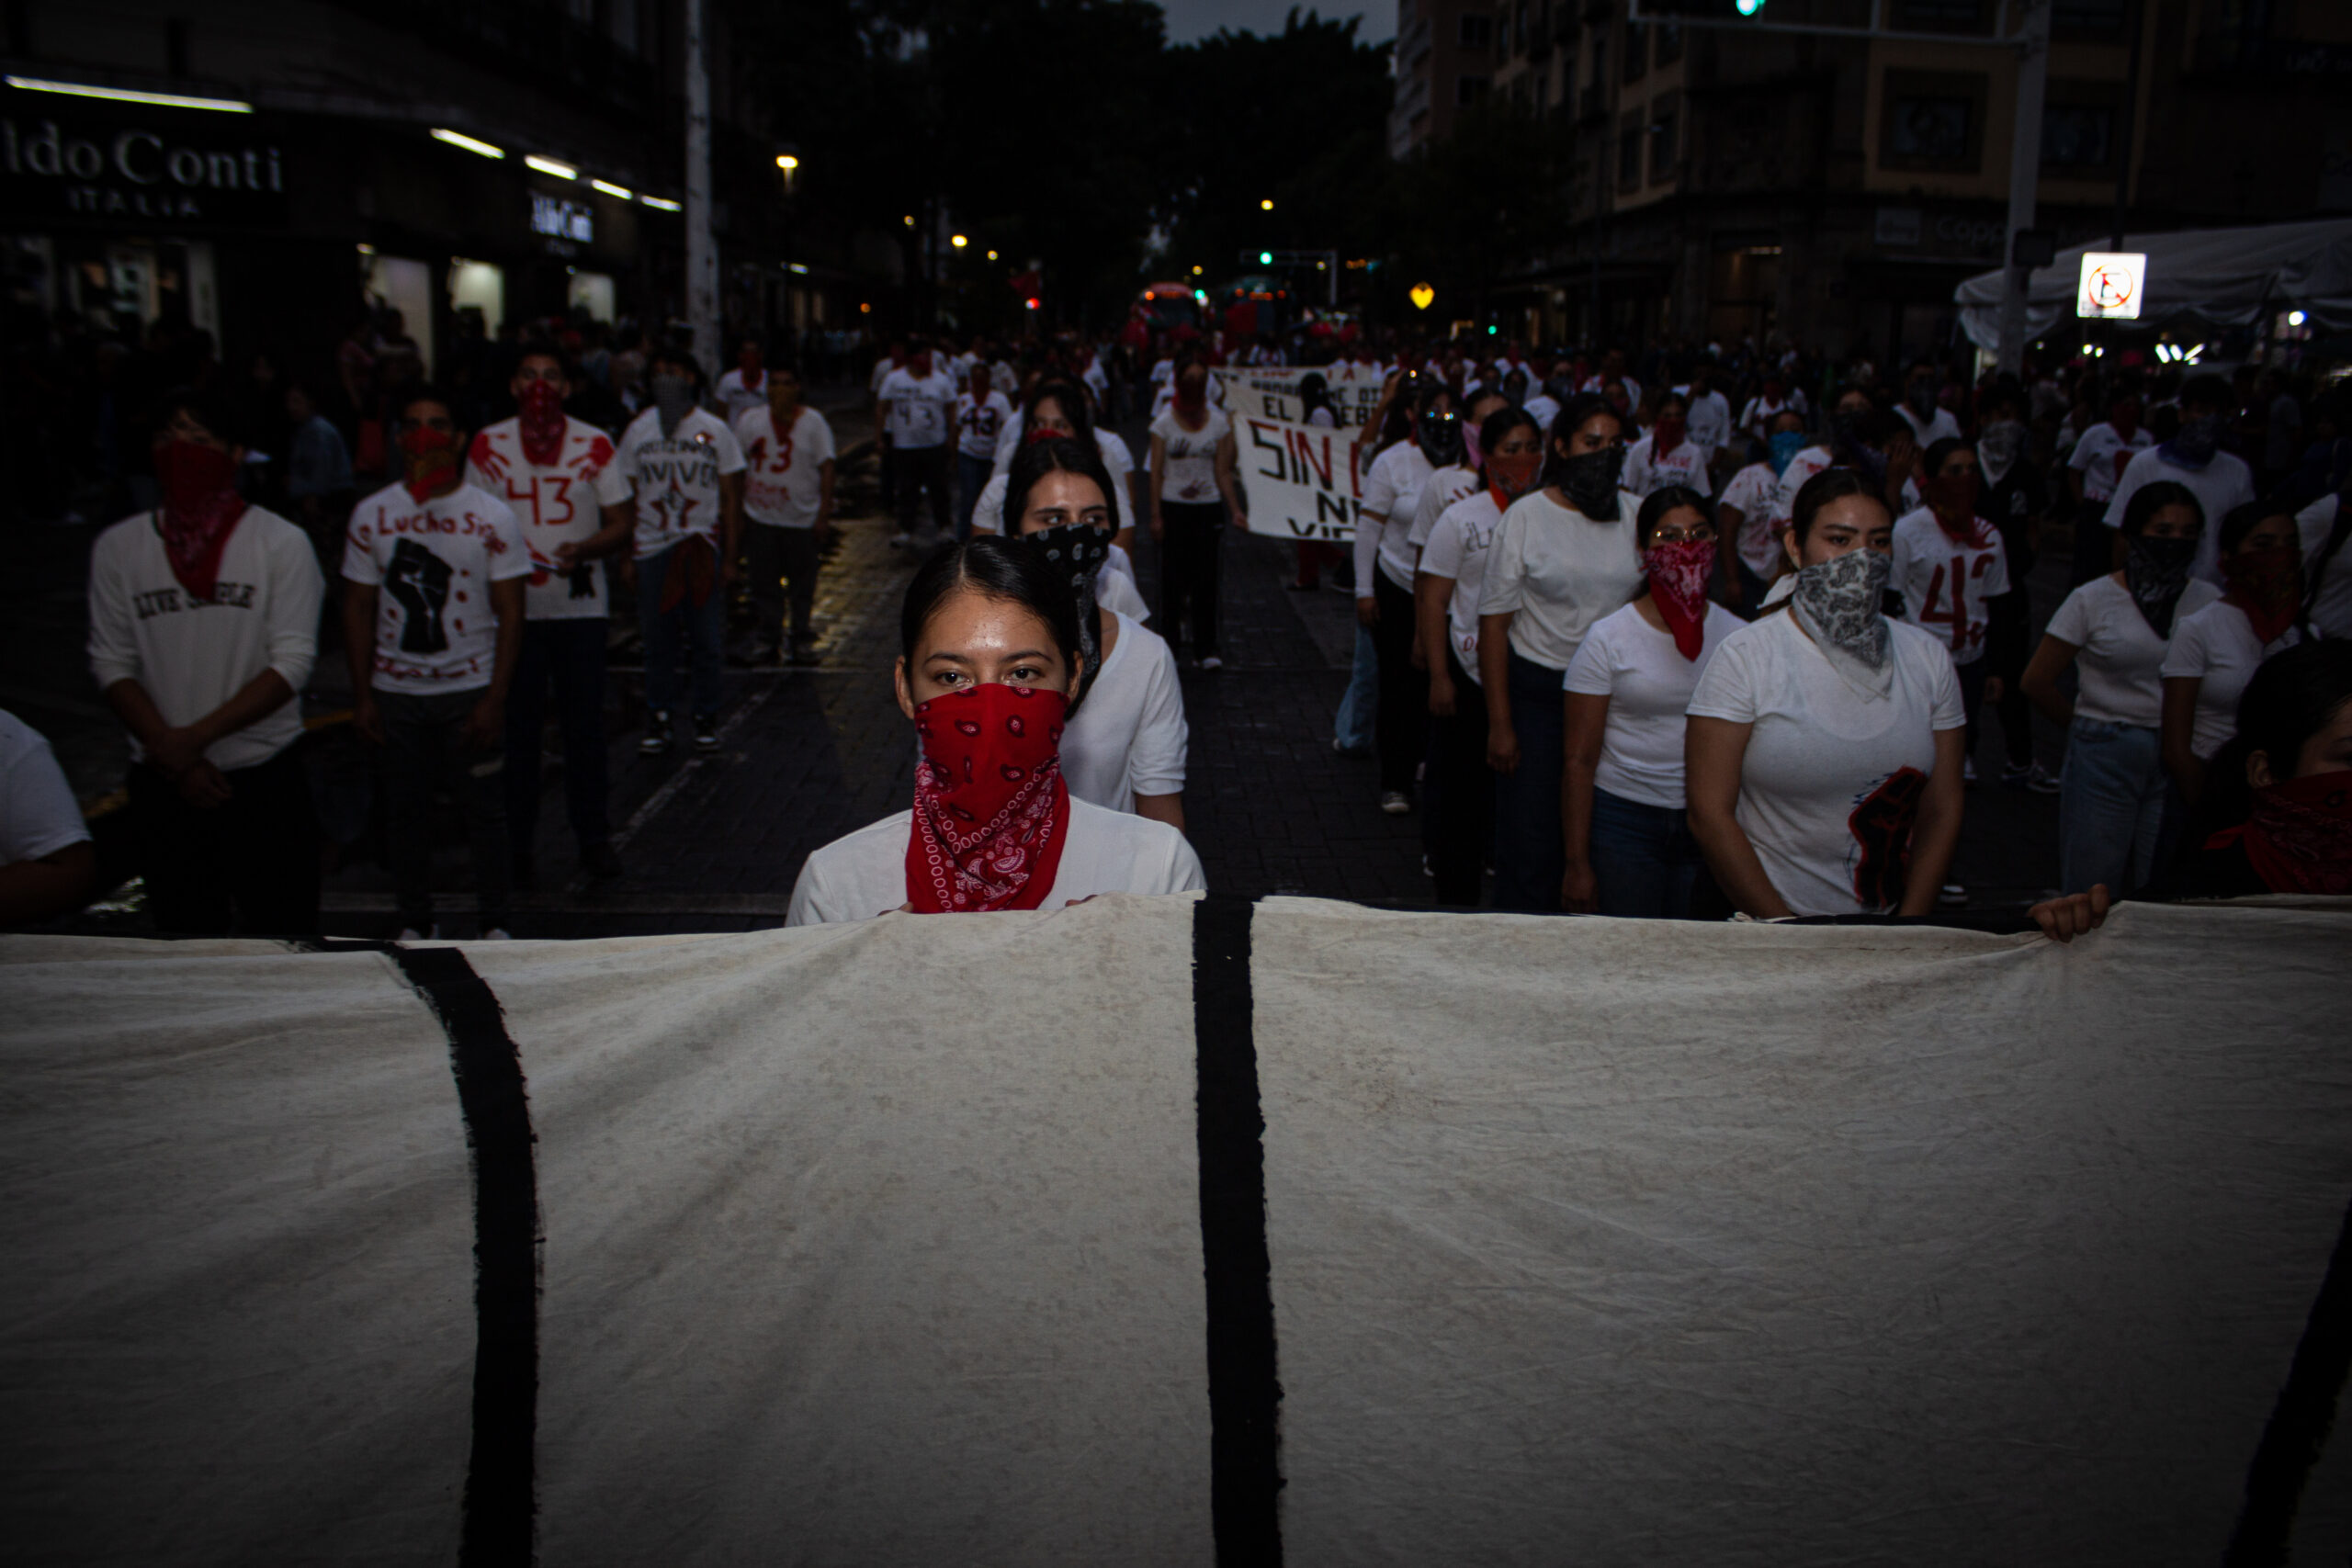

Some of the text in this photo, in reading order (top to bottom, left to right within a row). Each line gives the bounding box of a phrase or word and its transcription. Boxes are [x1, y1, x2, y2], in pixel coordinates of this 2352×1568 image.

[111, 127, 285, 193] Conti
[64, 186, 204, 219] ITALIA
[962, 406, 999, 435] 43
[1262, 396, 1294, 422] EL
[749, 437, 792, 472] 43
[1249, 419, 1332, 491] SIN
[507, 477, 575, 525] 43
[377, 505, 458, 536] Lucha
[133, 588, 181, 620] LIVE
